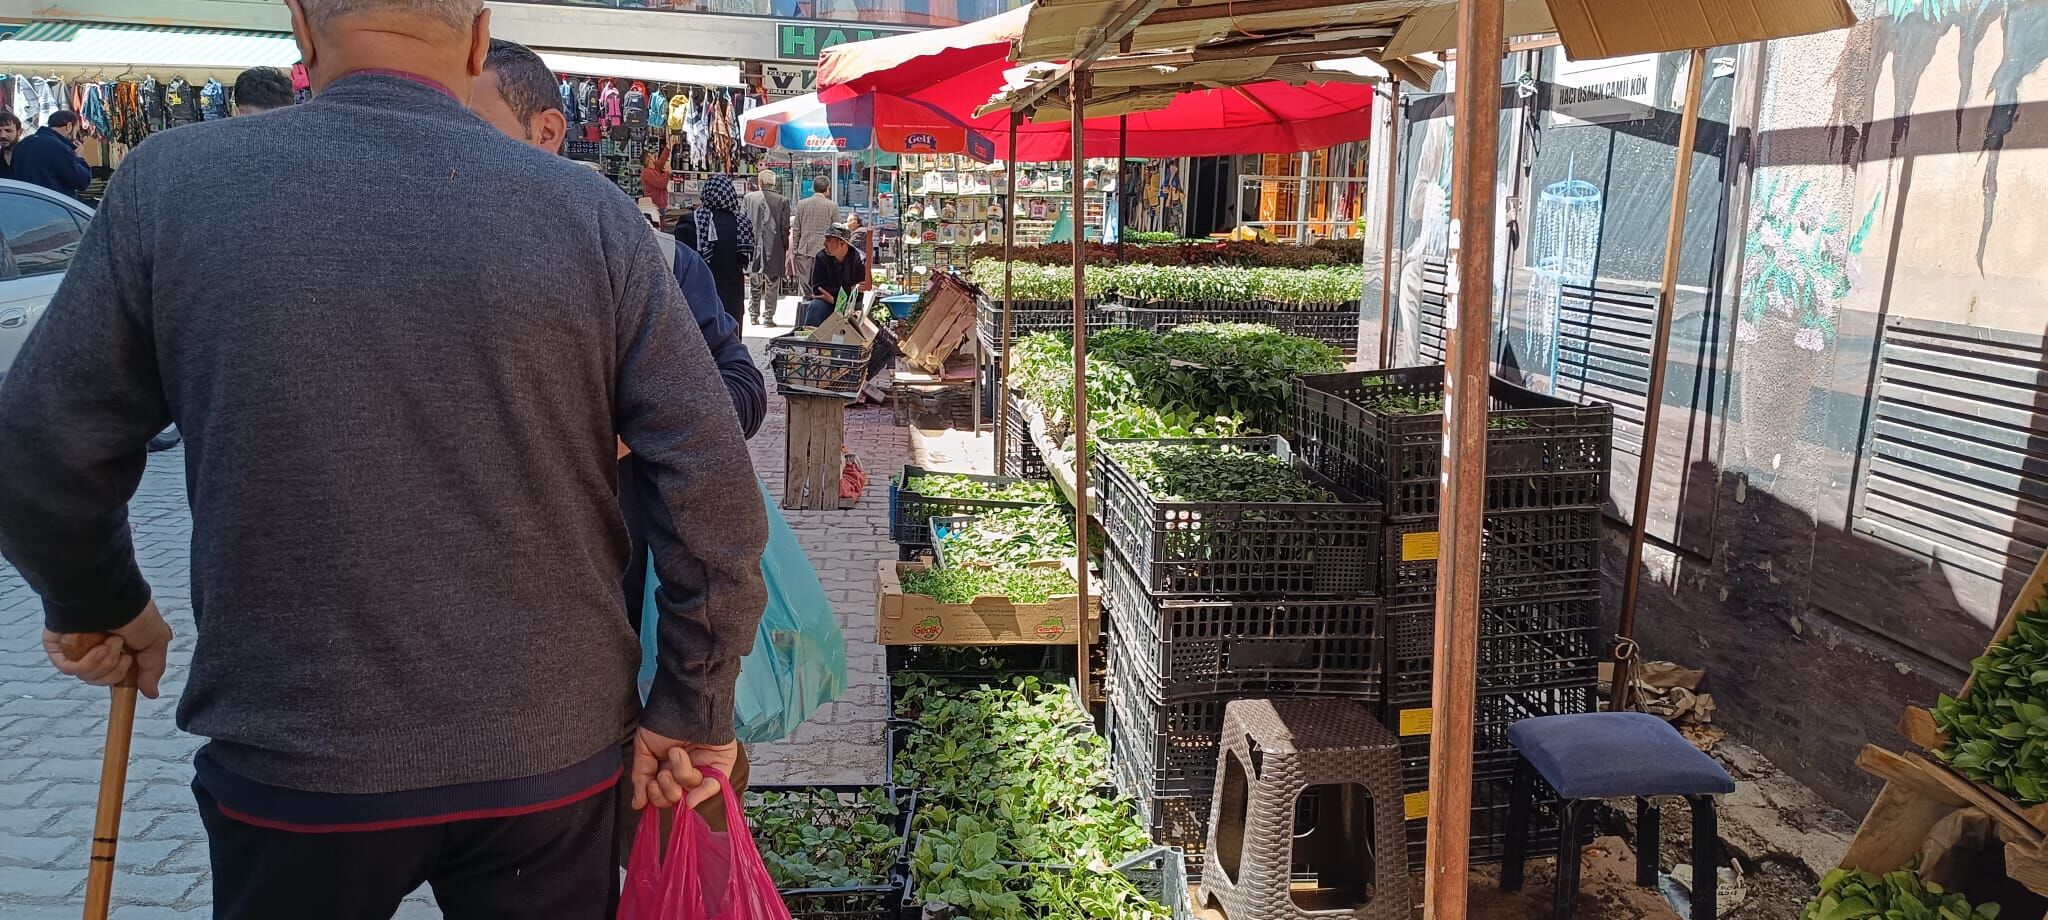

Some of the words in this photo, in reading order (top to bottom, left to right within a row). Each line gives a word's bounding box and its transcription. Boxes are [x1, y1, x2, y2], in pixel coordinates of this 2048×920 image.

[782, 26, 894, 56] HA
[1559, 87, 1576, 105] HACI
[1577, 83, 1604, 103] OSMAN
[1630, 75, 1648, 96] KÖK
[914, 625, 940, 635] Gedik
